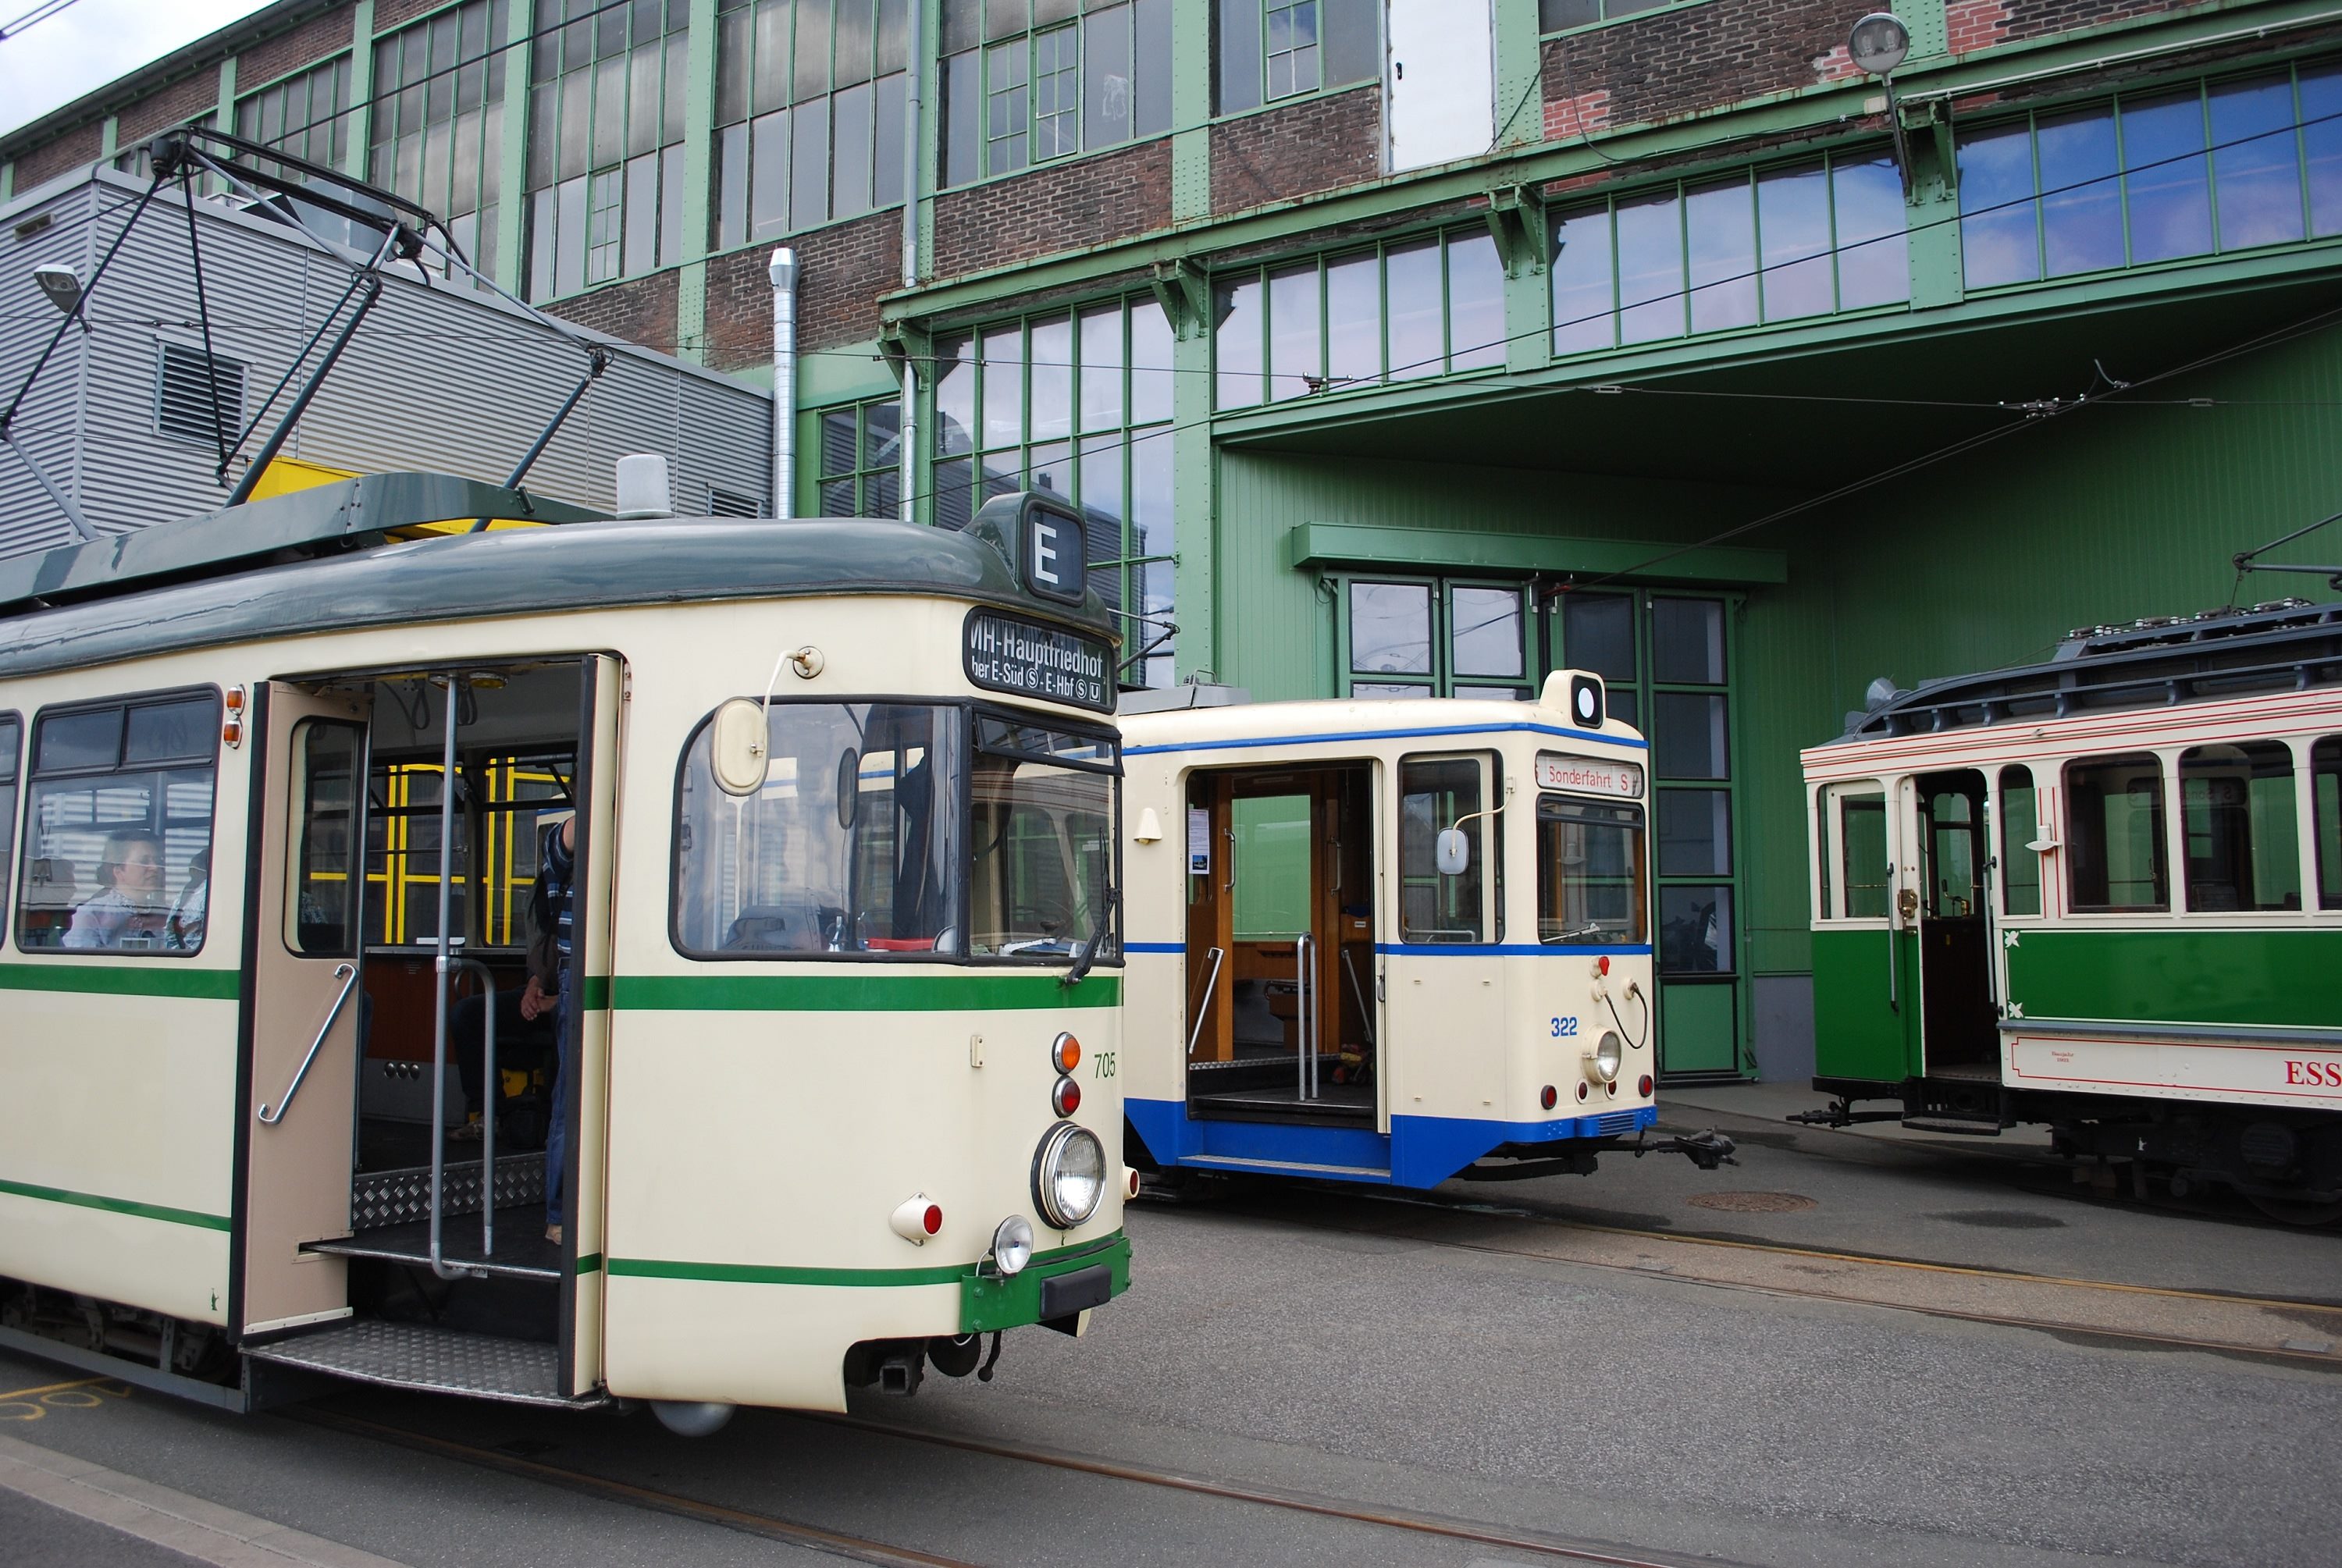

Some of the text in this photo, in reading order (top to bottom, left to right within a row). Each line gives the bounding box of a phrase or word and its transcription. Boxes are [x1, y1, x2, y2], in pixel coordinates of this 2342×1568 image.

[1034, 521, 1059, 585] E
[991, 660, 1023, 687] E-Süd
[1027, 669, 1038, 687] S
[1045, 672, 1074, 697] E-Hbf
[1090, 683, 1099, 701] U
[1549, 765, 1628, 791] Sonderfahrt S
[1550, 1016, 1578, 1036] 322
[1094, 1051, 1116, 1079] 705
[2284, 1060, 2342, 1087] ESS
